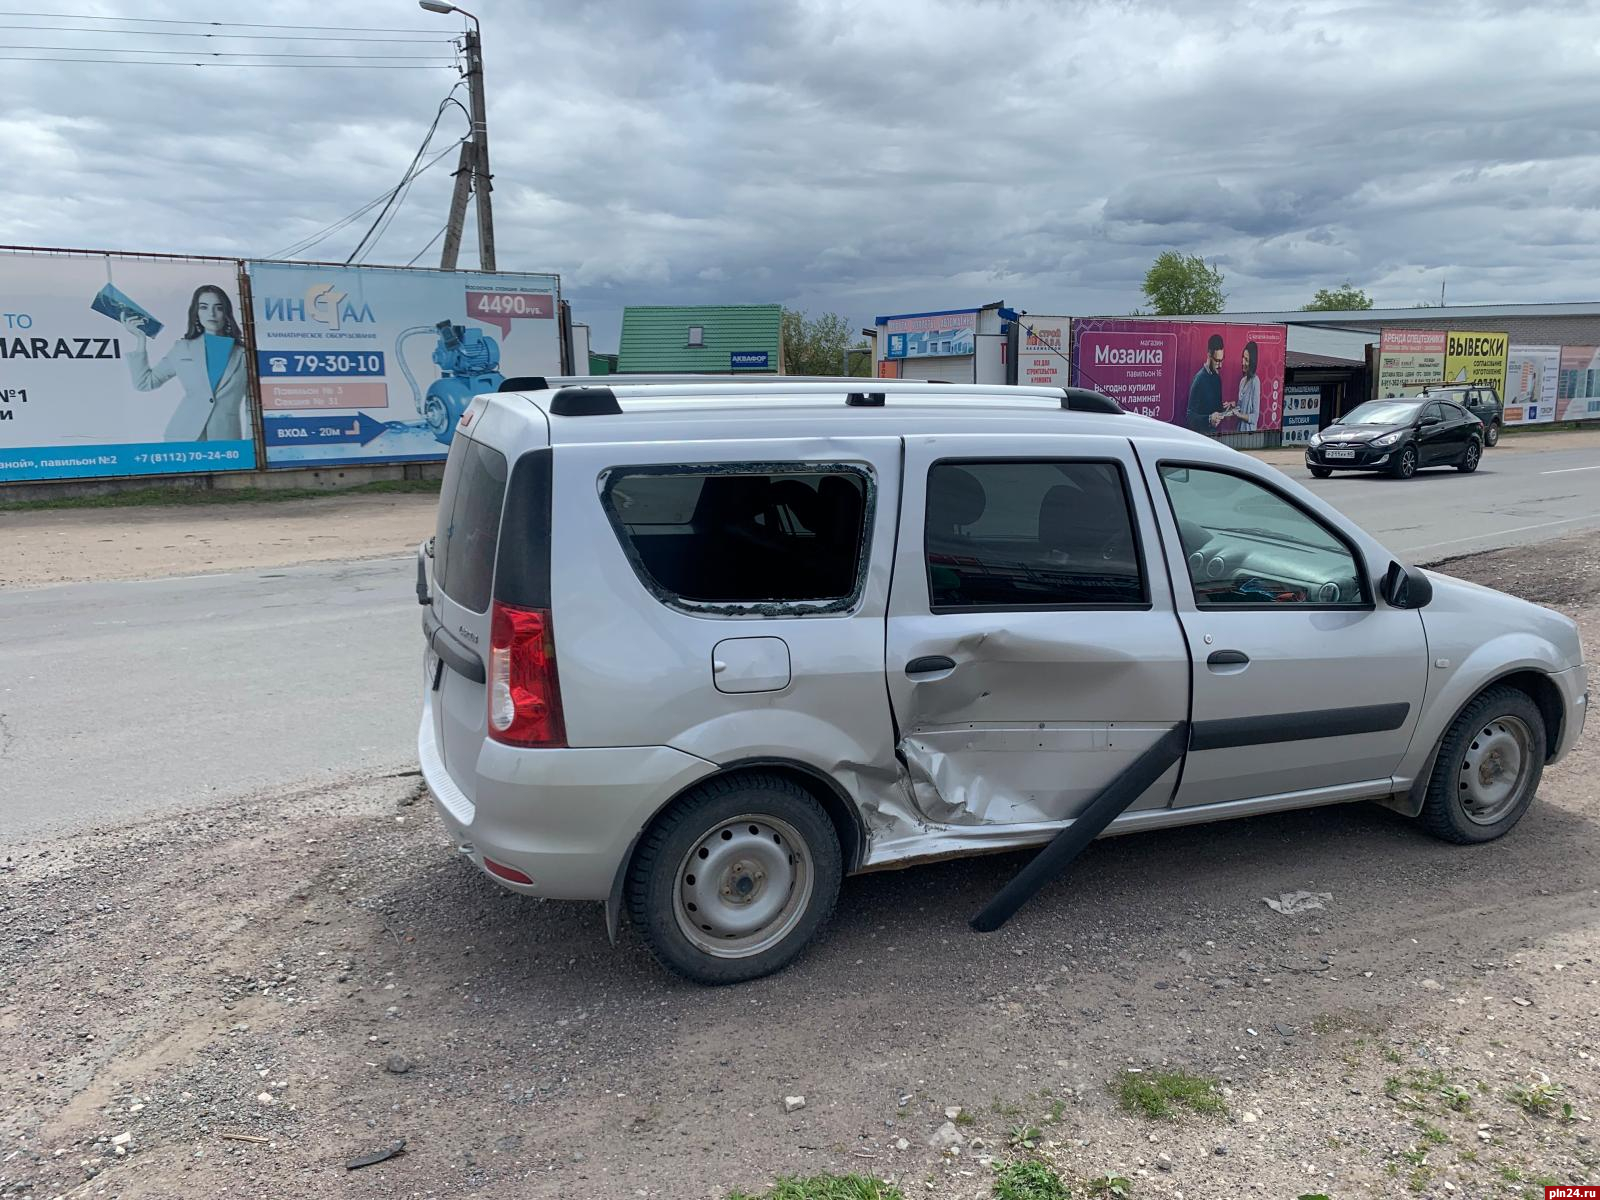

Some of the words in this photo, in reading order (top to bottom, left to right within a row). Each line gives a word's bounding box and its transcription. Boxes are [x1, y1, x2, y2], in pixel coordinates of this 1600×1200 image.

[478, 294, 526, 314] 4490
[1039, 328, 1062, 338] СТРОЙ
[1140, 339, 1164, 347] магазин
[1383, 333, 1406, 345] АРЕНДА
[1407, 333, 1444, 344] СПЕЦТЕХНИКИ
[1448, 337, 1505, 356] ВЫВЕСКИ
[293, 355, 380, 372] 79-30-10
[1126, 369, 1156, 378] павильон
[273, 387, 320, 396] Павильон
[1128, 383, 1156, 394] купили
[1128, 393, 1161, 404] ламинат!
[1142, 405, 1161, 417] Вы?
[1288, 417, 1310, 425] БЫТОВАЯ
[277, 428, 309, 438] ВХОД
[40, 457, 96, 467] павильон
[98, 455, 118, 465] №2
[134, 453, 148, 463] +7
[150, 452, 187, 464] (8112)
[188, 450, 240, 461] 70-24-80
